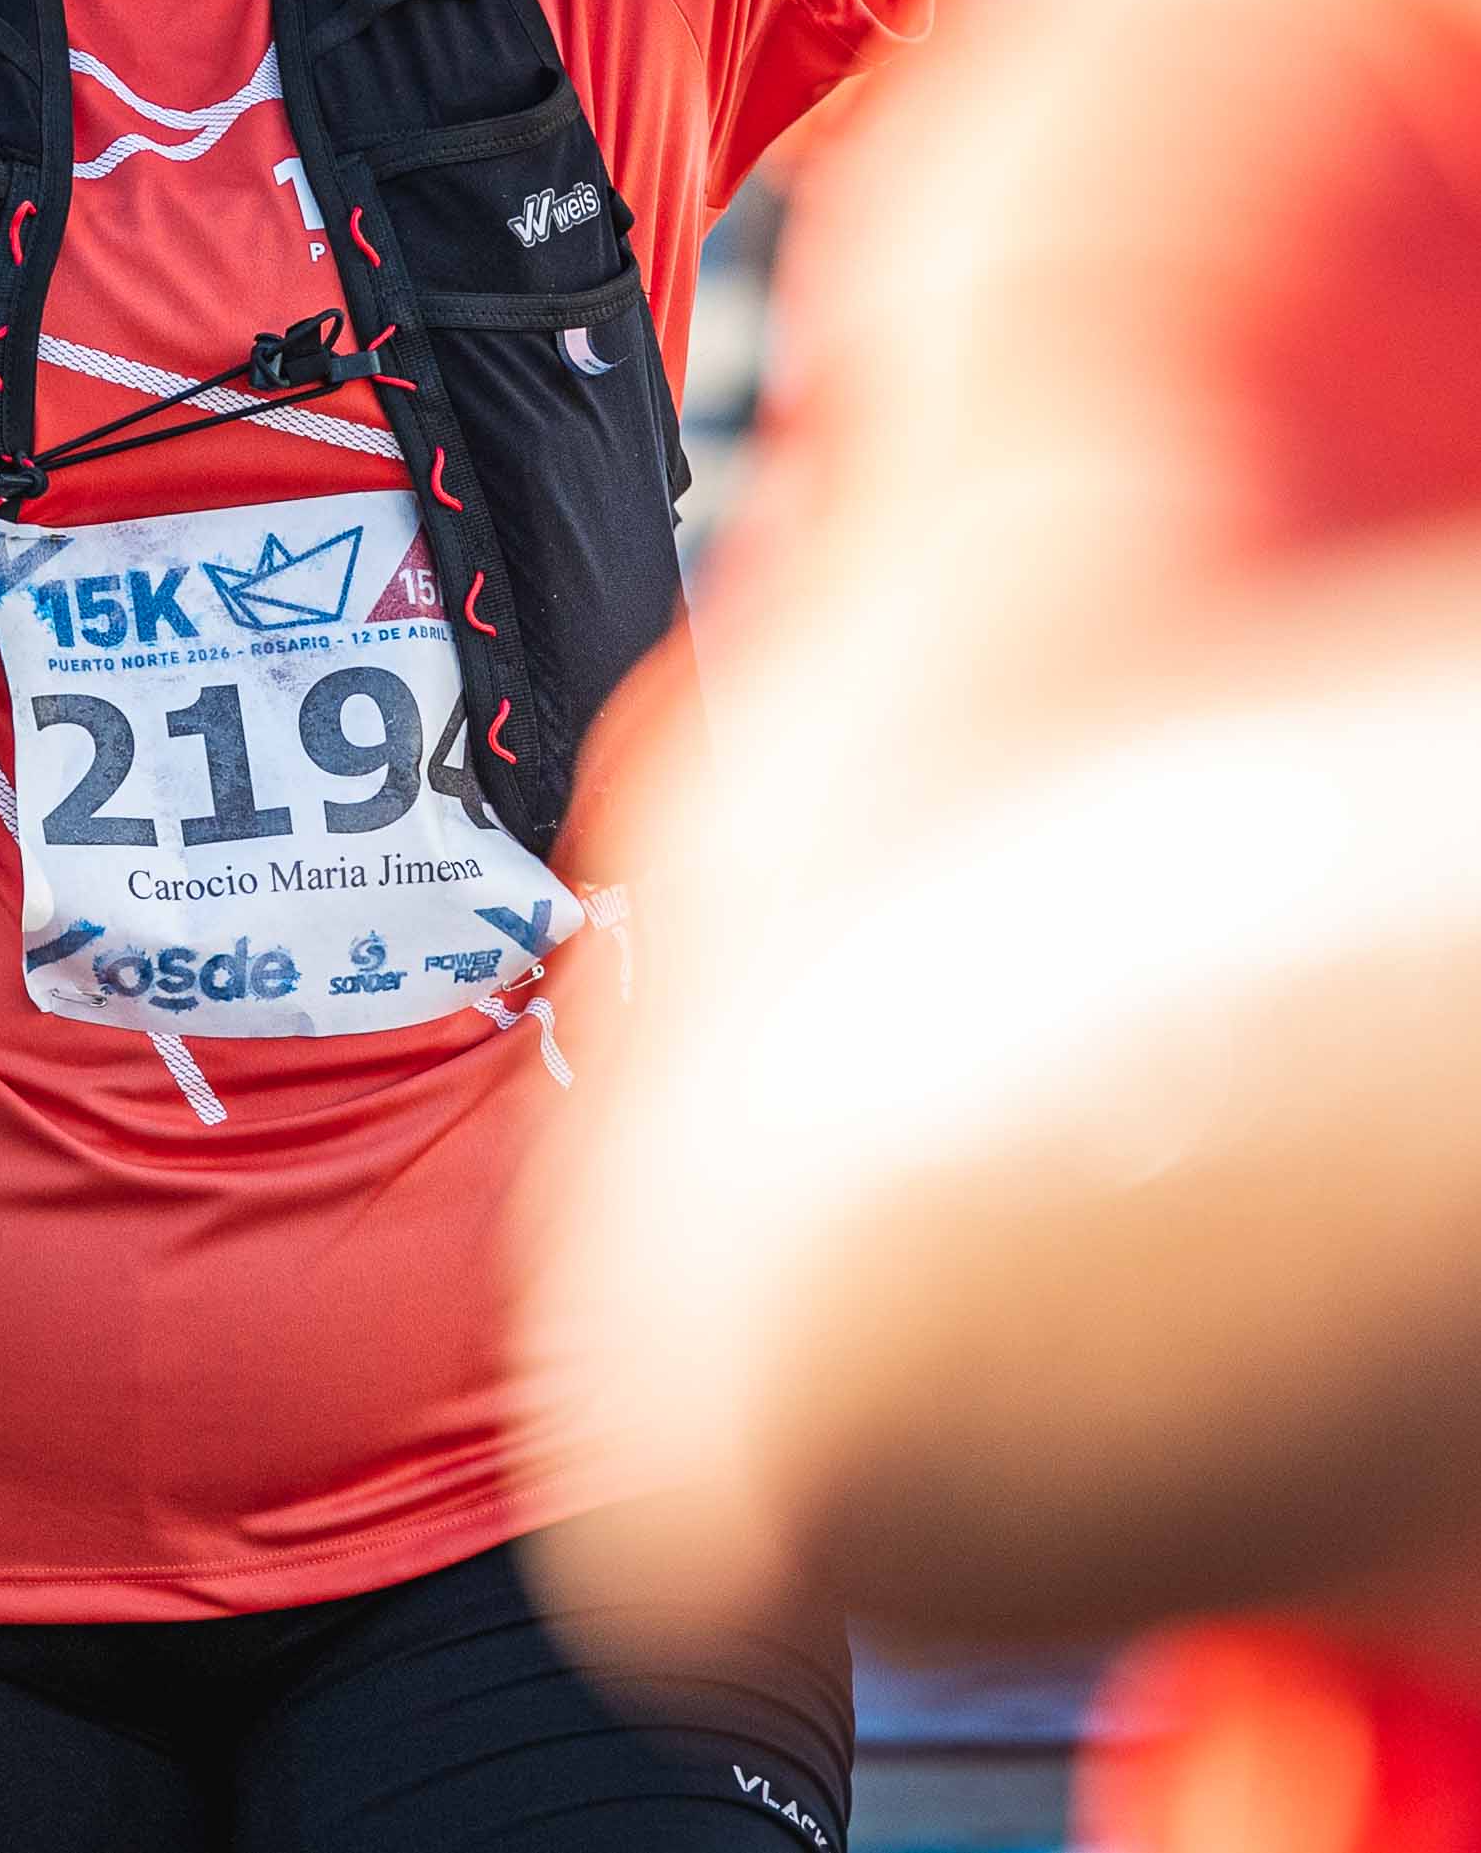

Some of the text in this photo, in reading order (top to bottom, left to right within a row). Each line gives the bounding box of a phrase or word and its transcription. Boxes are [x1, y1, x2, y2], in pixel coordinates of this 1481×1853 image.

[553, 189, 597, 228] weis
[39, 567, 201, 649] 15K
[399, 568, 445, 607] 15
[48, 658, 115, 673] PUERTO
[122, 651, 181, 670] NORTE
[188, 646, 230, 664] 2026
[251, 635, 330, 656] ROSARIO
[351, 630, 372, 645] 12
[379, 627, 401, 642] DE
[408, 625, 449, 642] ABRIL
[127, 852, 484, 901] Carocio Maria Jimena
[102, 936, 299, 1010] osde
[425, 948, 503, 972] POWER
